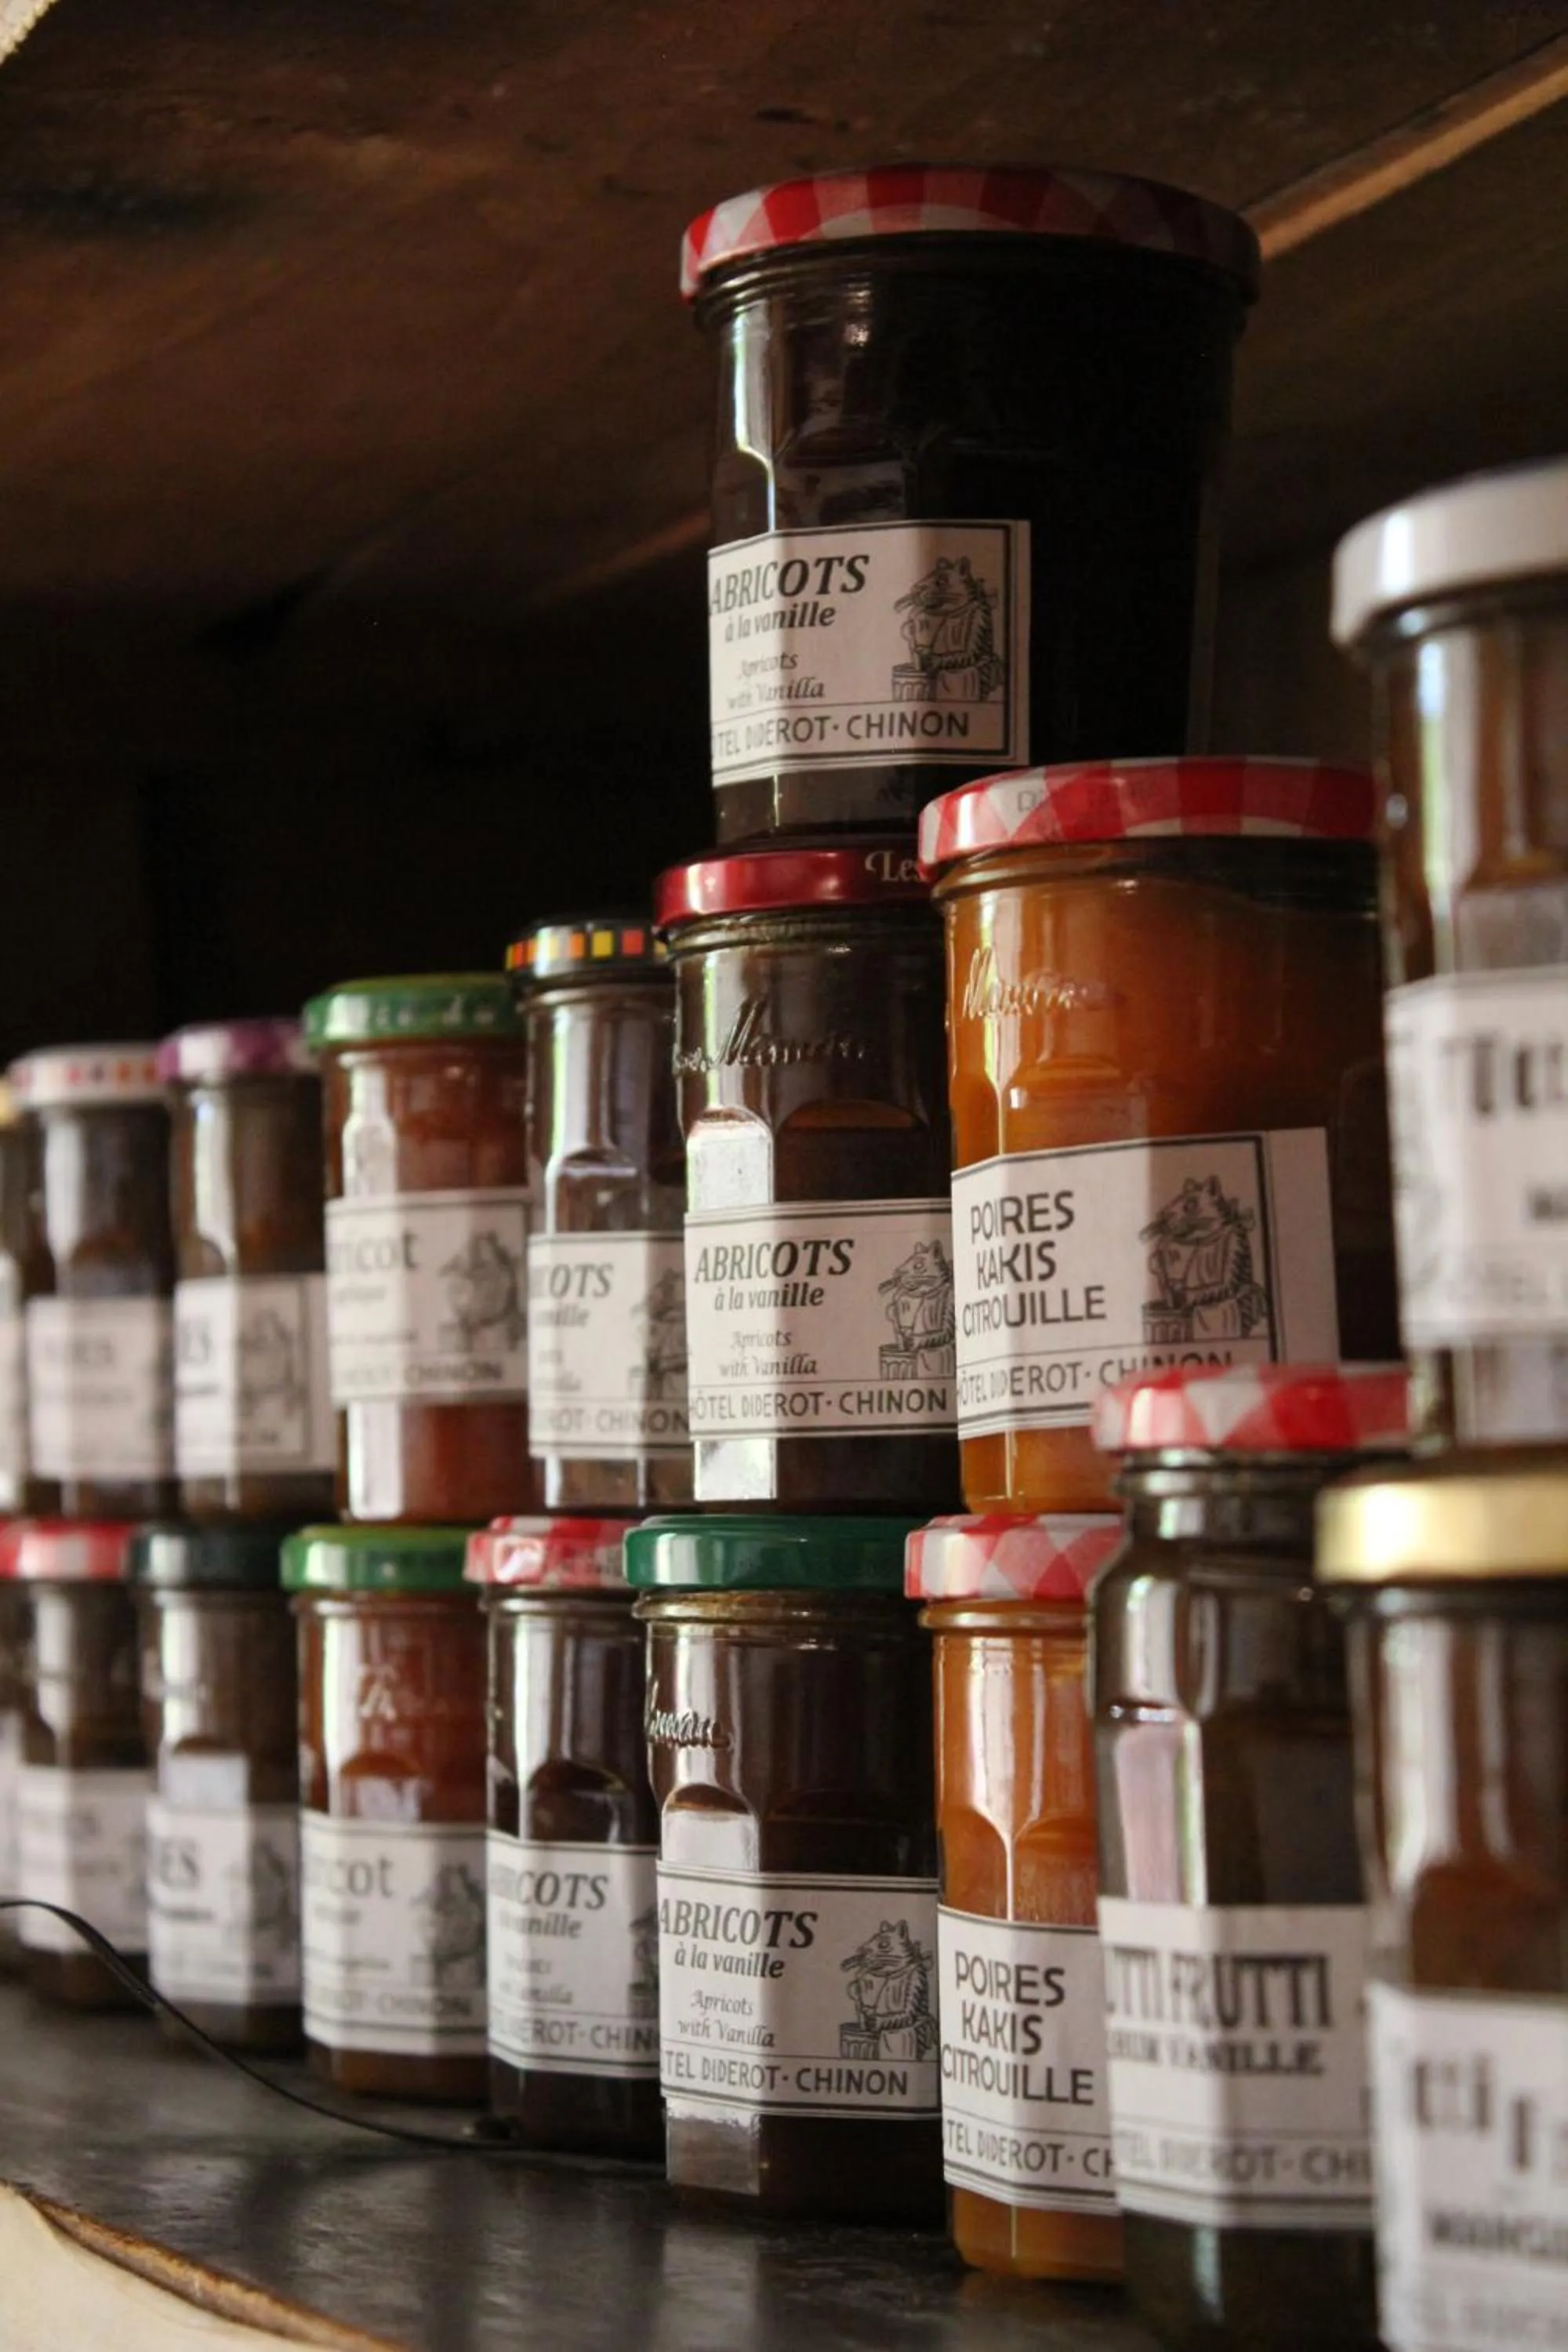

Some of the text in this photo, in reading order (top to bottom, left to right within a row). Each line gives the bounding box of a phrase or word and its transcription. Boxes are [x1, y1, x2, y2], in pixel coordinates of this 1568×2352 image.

[709, 554, 869, 615] ABRICOTS
[753, 602, 837, 635] vanille
[713, 728, 741, 757] TEL
[846, 710, 970, 740] CHINON
[971, 1190, 1075, 1243] POIRES
[695, 1239, 855, 1284] ABRICOTS
[976, 1240, 1057, 1290] KAKIS
[728, 1284, 743, 1310] la
[748, 1282, 825, 1309] vanille
[963, 1285, 1108, 1338] CITROUILLE
[741, 1391, 825, 1419] DIDEROT
[839, 1388, 947, 1416] CHINON
[659, 1897, 819, 1950] ABRICOTS
[673, 1940, 786, 1980] à la vanille
[954, 1951, 1067, 2008] POIRES
[689, 1989, 754, 2017] Apricots
[590, 2024, 660, 2053] CHIN
[677, 2015, 776, 2049] with Vanilla
[962, 2000, 1044, 2056] KAKIS
[661, 2050, 908, 2096] TEL DIDEROT CHINON
[941, 2042, 1095, 2106] CITROUILLE
[944, 2118, 974, 2158] TEL
[976, 2128, 1064, 2174] DIDEROT
